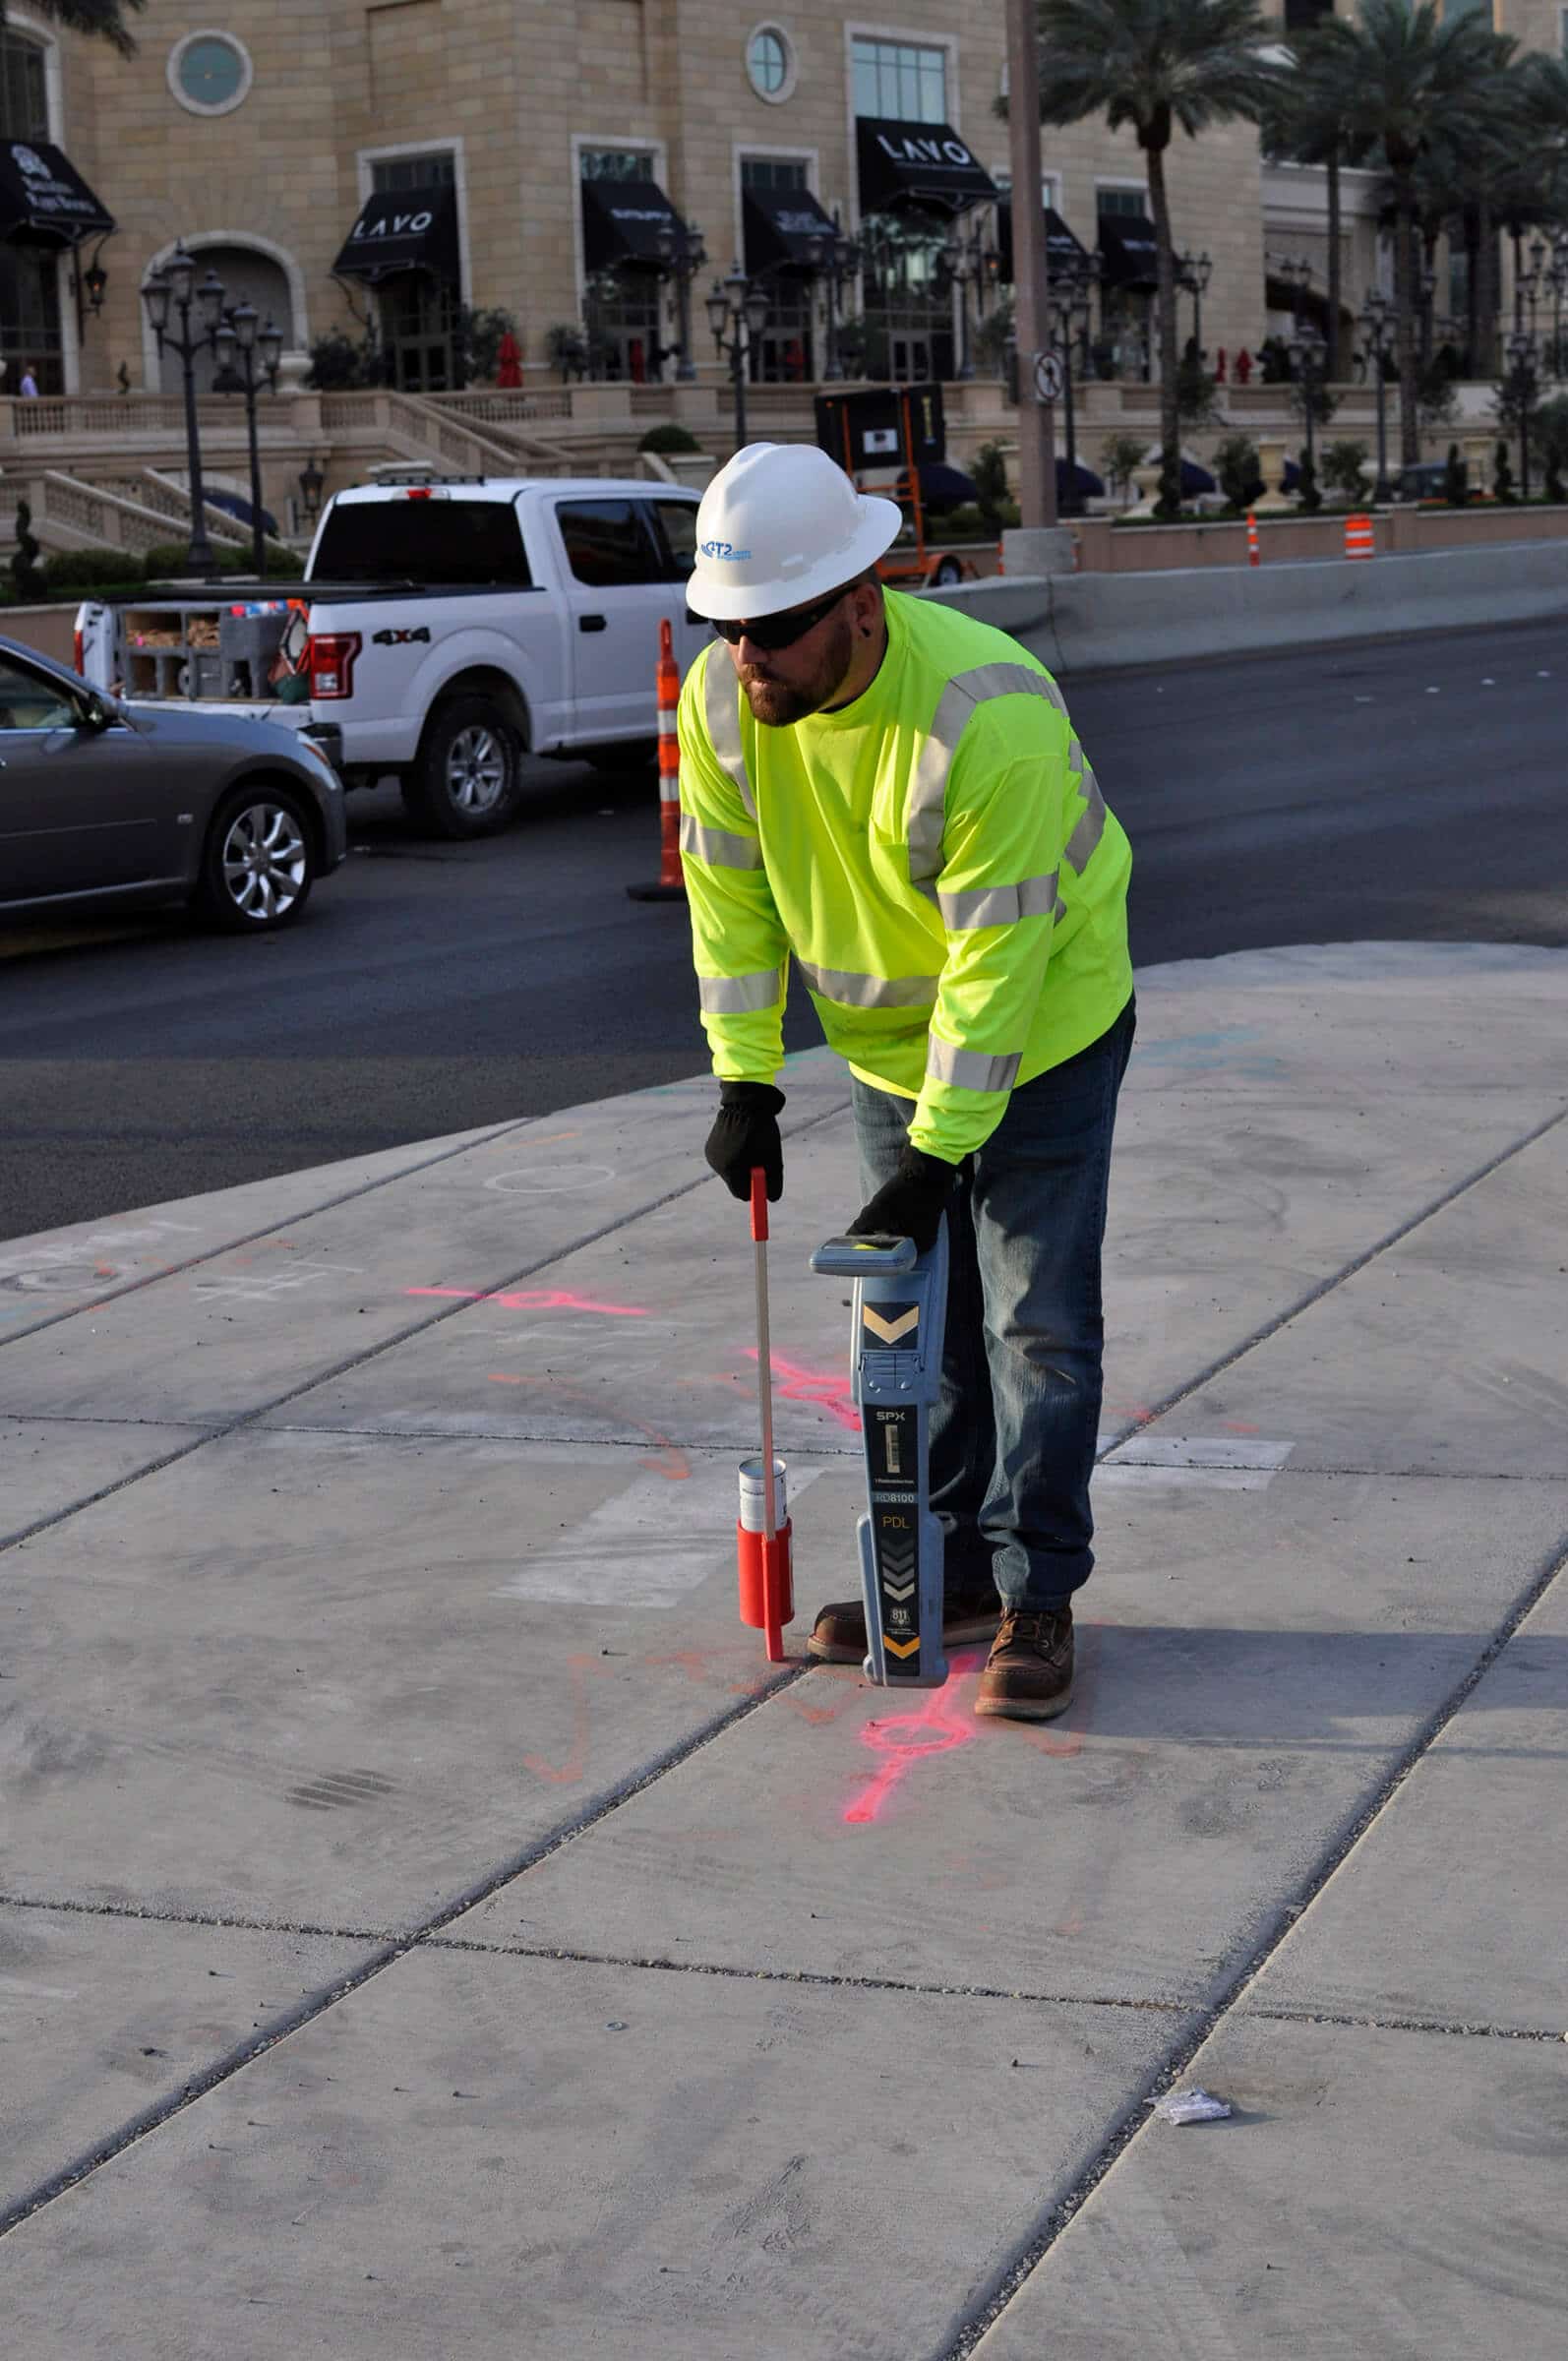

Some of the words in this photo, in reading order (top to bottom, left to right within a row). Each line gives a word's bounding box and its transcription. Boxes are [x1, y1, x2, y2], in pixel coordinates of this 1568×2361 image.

[877, 136, 971, 164] LAVO
[353, 212, 433, 237] LAVO
[876, 1411, 905, 1421] SPX
[882, 1516, 911, 1529] PDL
[892, 1607, 907, 1620] 811
